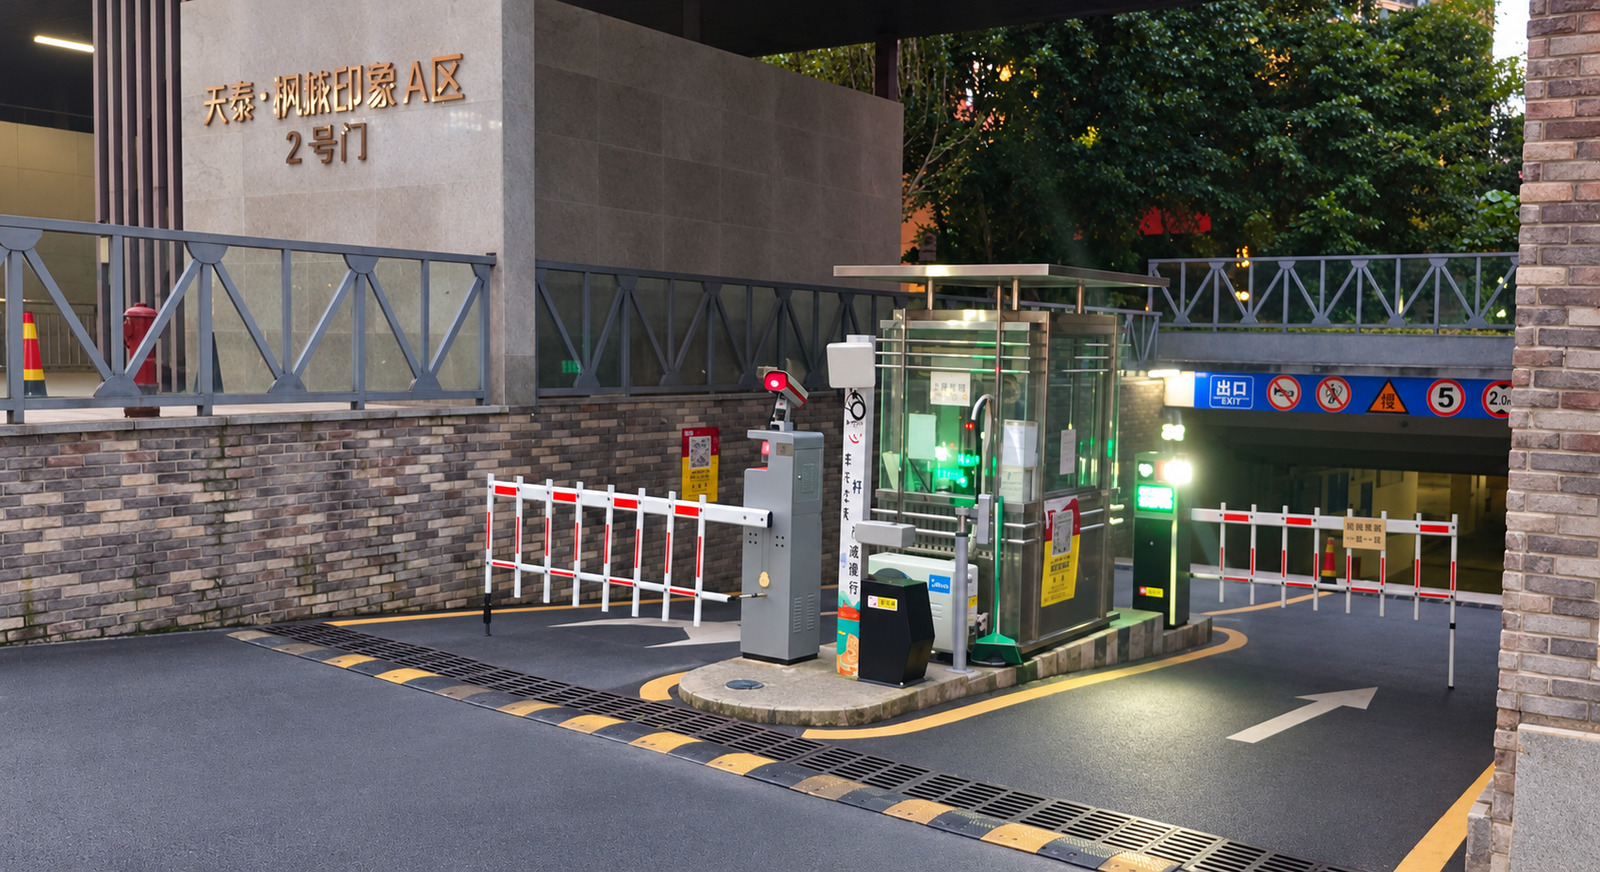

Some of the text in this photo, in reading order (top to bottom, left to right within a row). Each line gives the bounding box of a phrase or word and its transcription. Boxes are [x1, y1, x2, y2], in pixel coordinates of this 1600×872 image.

[285, 121, 368, 165] 2号门
[1216, 379, 1247, 397] 出口
[1221, 397, 1241, 406] EXIT
[1380, 393, 1396, 410] 慢
[1438, 387, 1454, 408] 5
